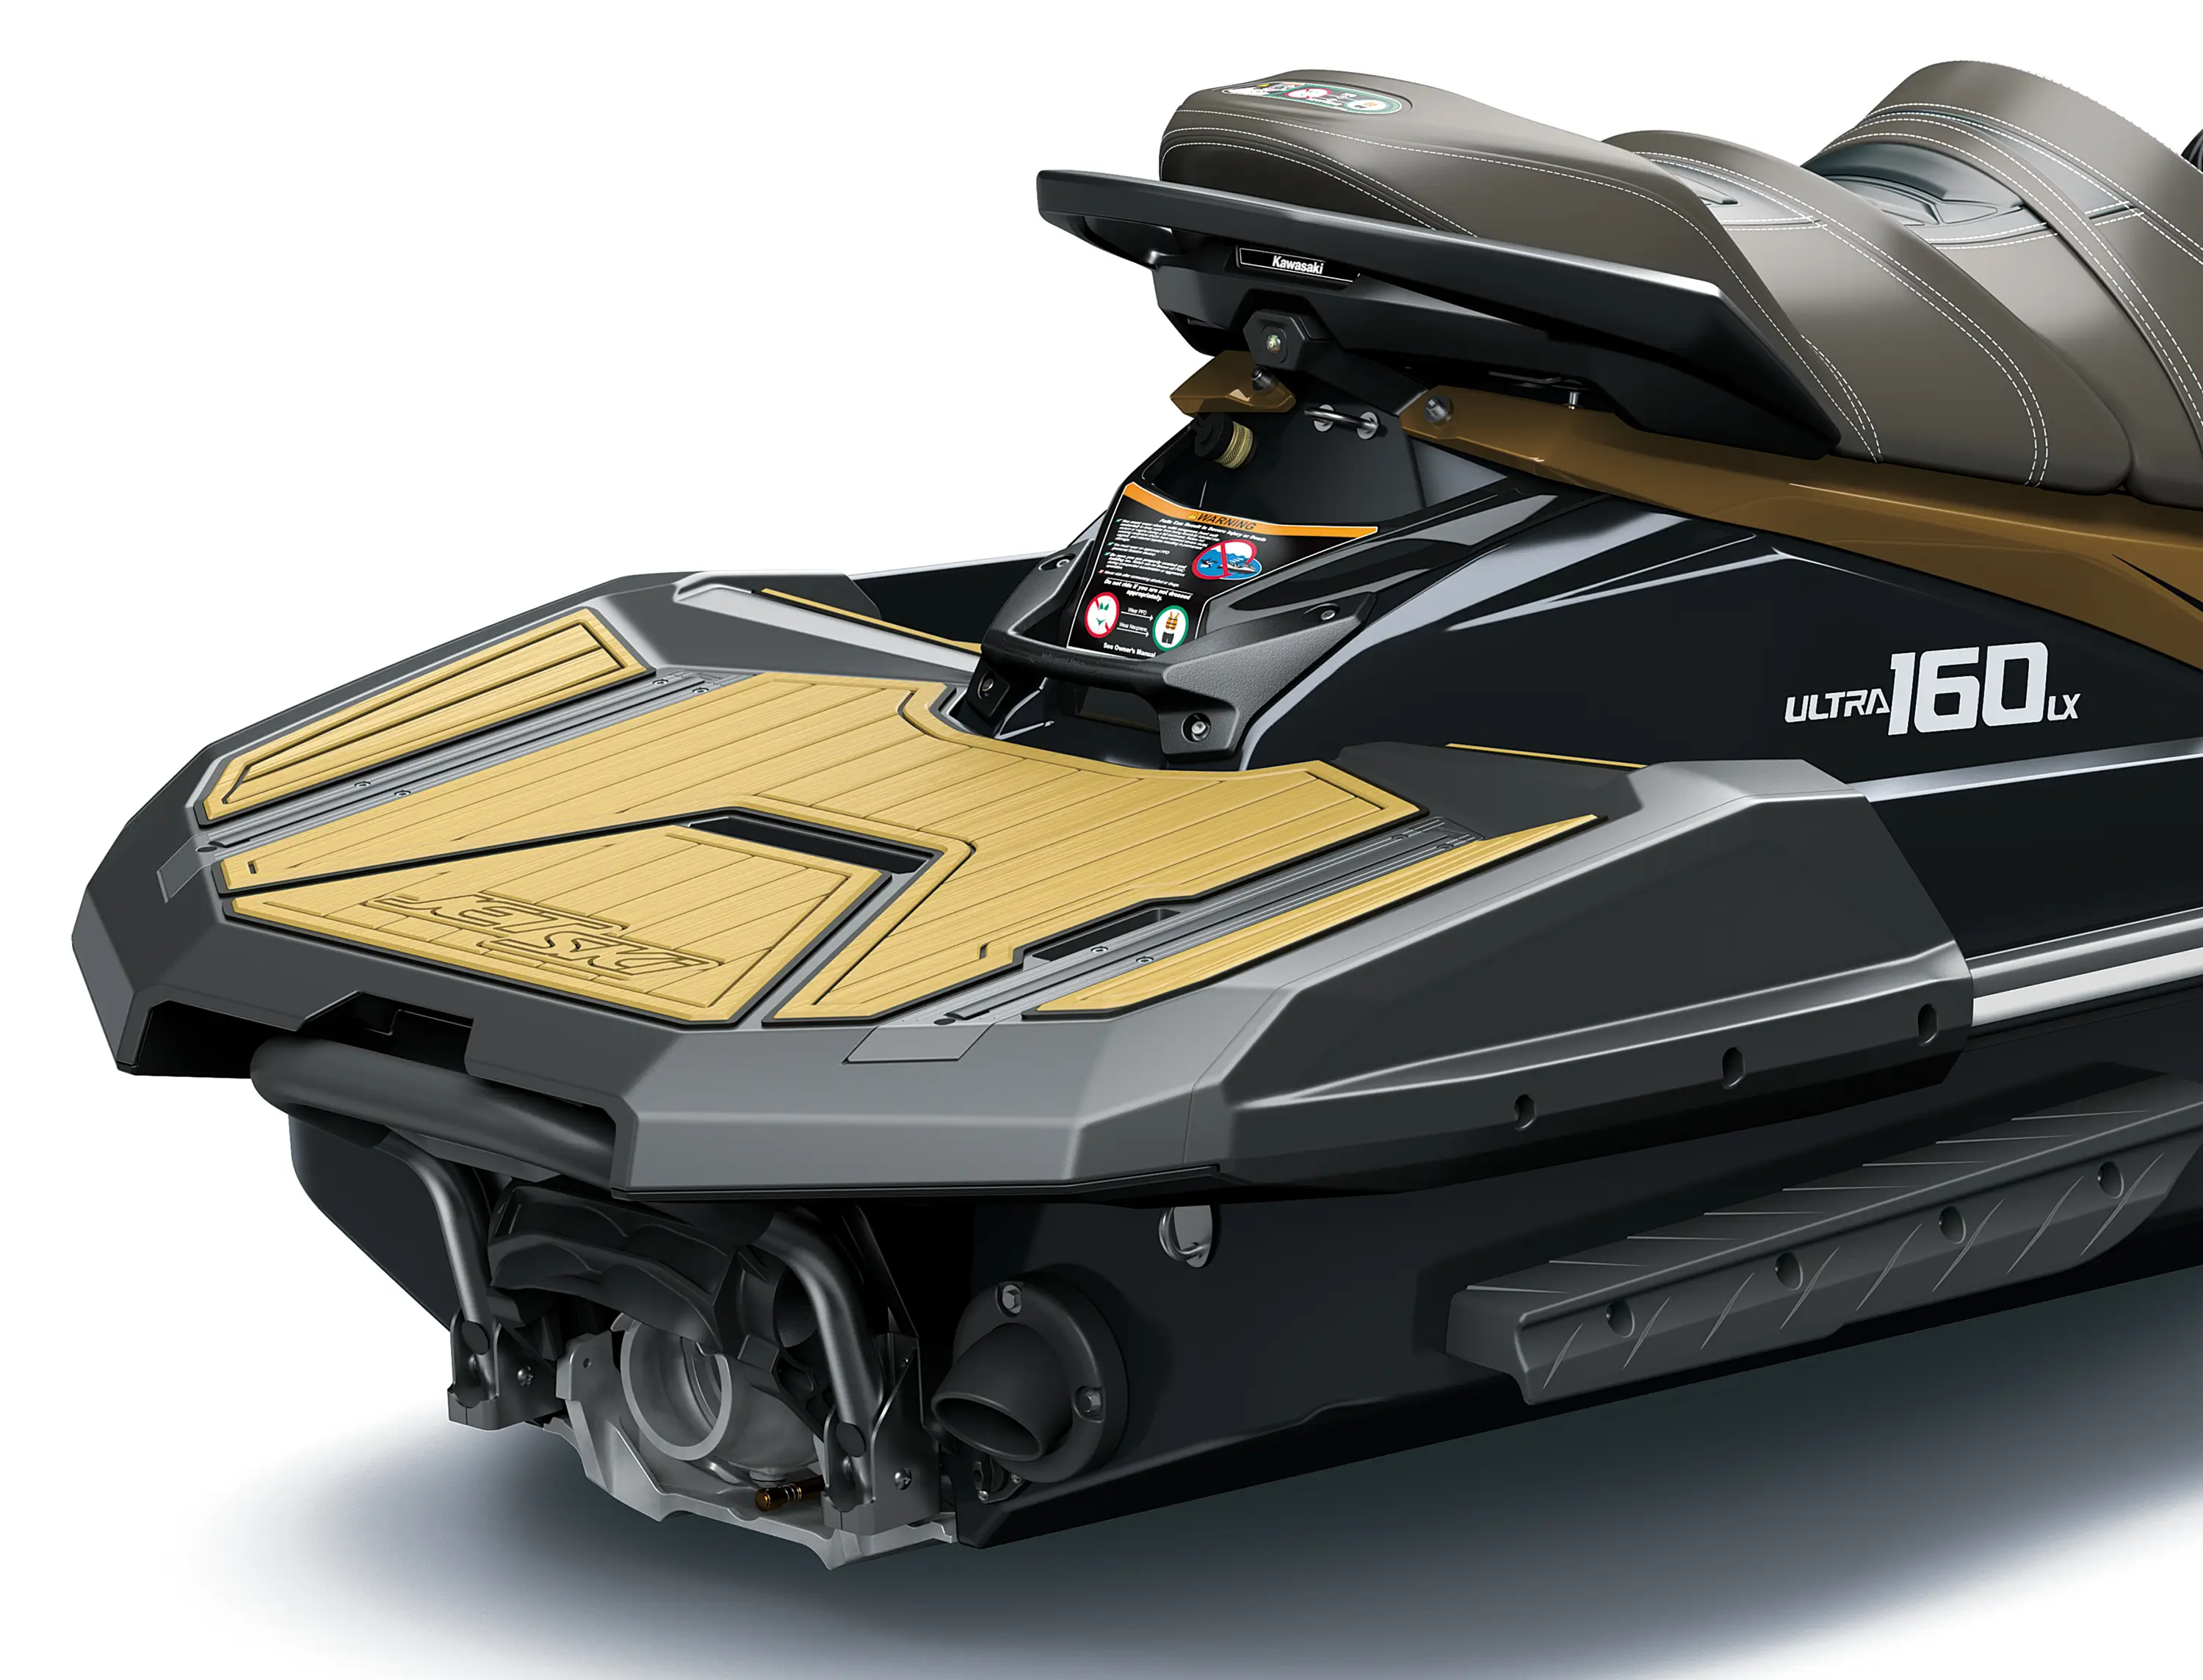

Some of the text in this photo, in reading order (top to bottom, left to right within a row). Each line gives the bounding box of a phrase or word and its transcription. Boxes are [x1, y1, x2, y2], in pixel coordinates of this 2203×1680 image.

[1272, 255, 1325, 275] Kawasaki
[1197, 513, 1256, 530] WARNING
[1168, 591, 1192, 601] dressed
[1129, 623, 1148, 632] Neoprene
[1103, 642, 1157, 658] See Owner's Manual
[1784, 641, 2081, 736] ULTRA 160 LX
